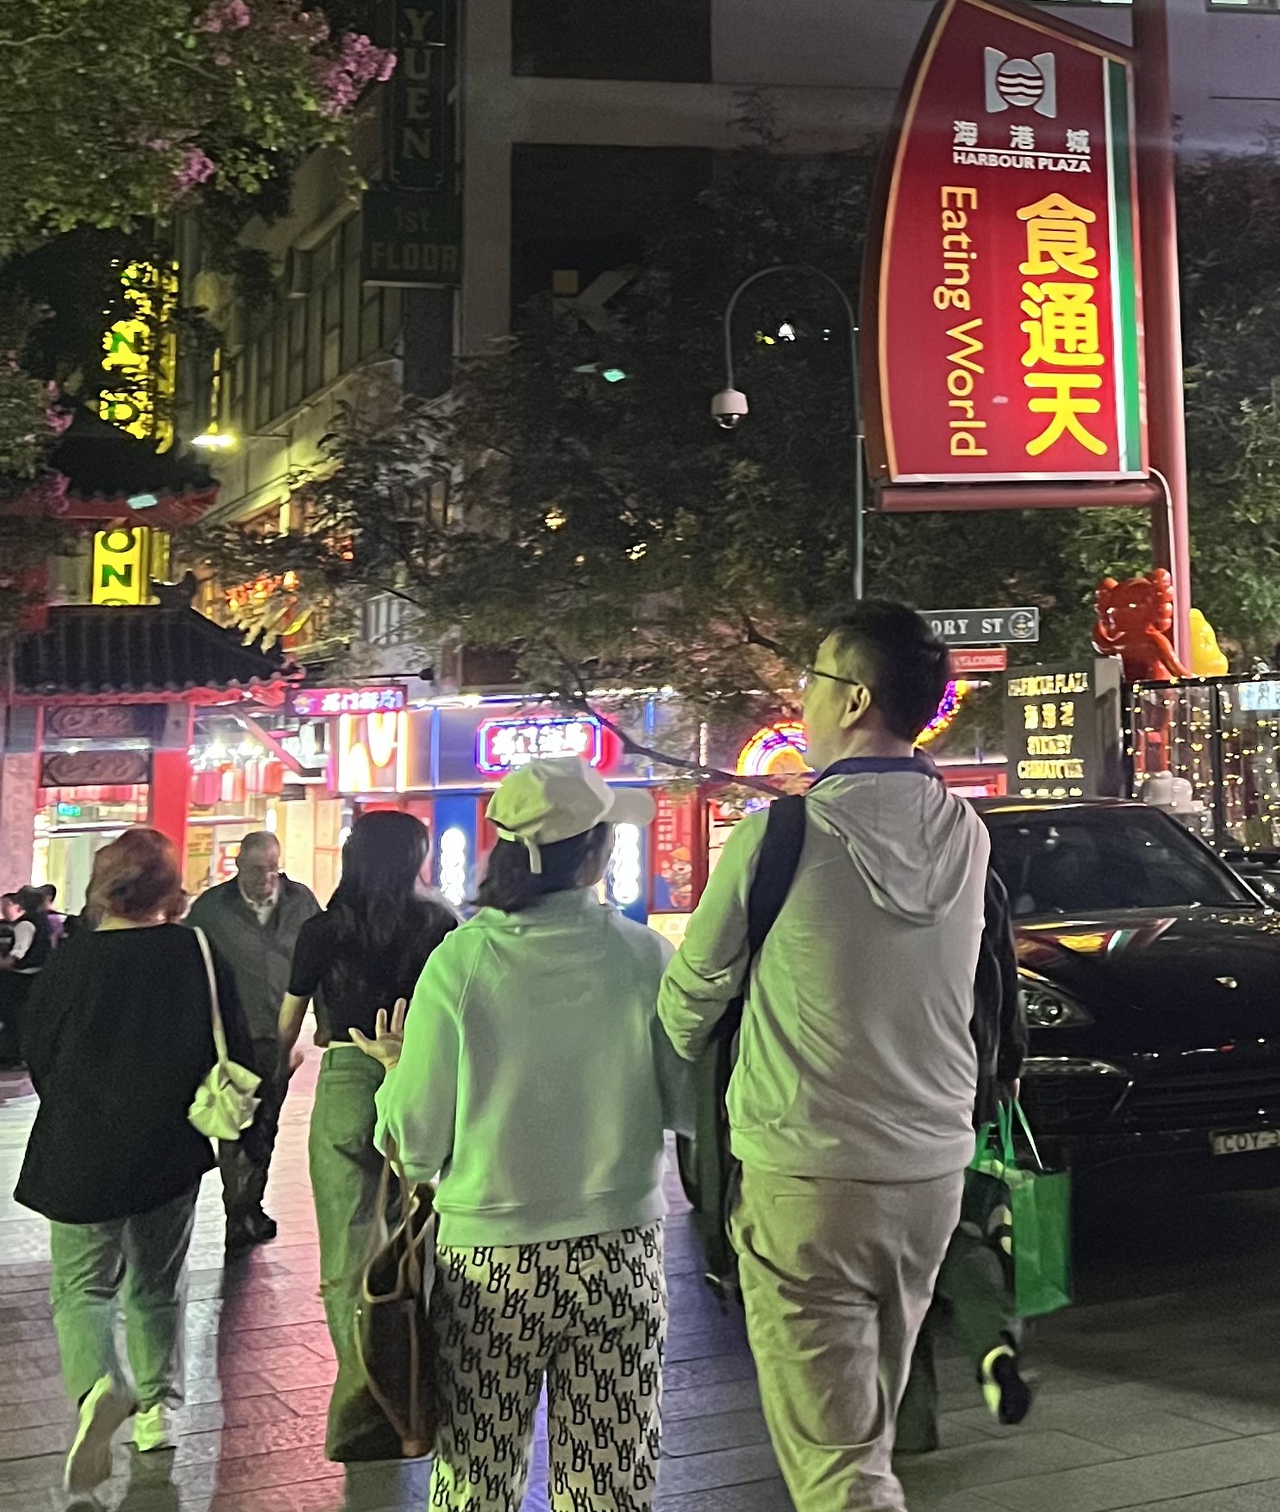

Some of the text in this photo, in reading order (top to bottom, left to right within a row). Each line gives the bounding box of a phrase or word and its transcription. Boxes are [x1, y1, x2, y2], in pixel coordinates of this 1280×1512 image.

[401, 7, 436, 160] YUEN
[952, 151, 1092, 173] HARBOUR PLAZA
[371, 241, 459, 273] FLOOR
[932, 185, 988, 456] Eating World
[1016, 192, 1108, 456] 食通天
[930, 618, 1004, 637] ORY ST
